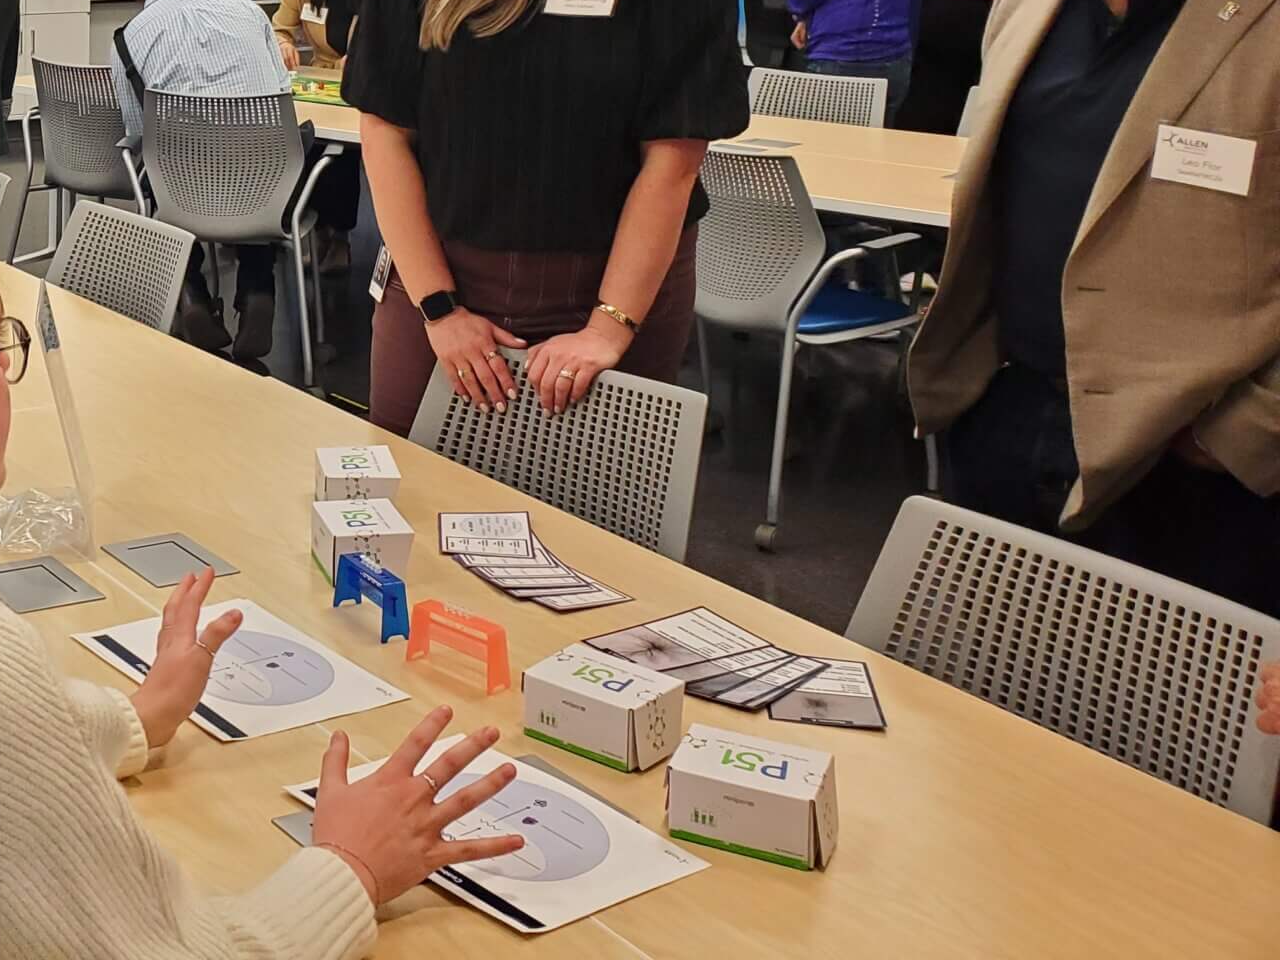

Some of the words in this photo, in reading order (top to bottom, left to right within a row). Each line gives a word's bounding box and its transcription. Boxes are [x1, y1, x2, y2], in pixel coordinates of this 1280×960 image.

[1176, 137, 1209, 149] ALLEN
[571, 664, 634, 693] P51
[719, 749, 789, 781] P51
